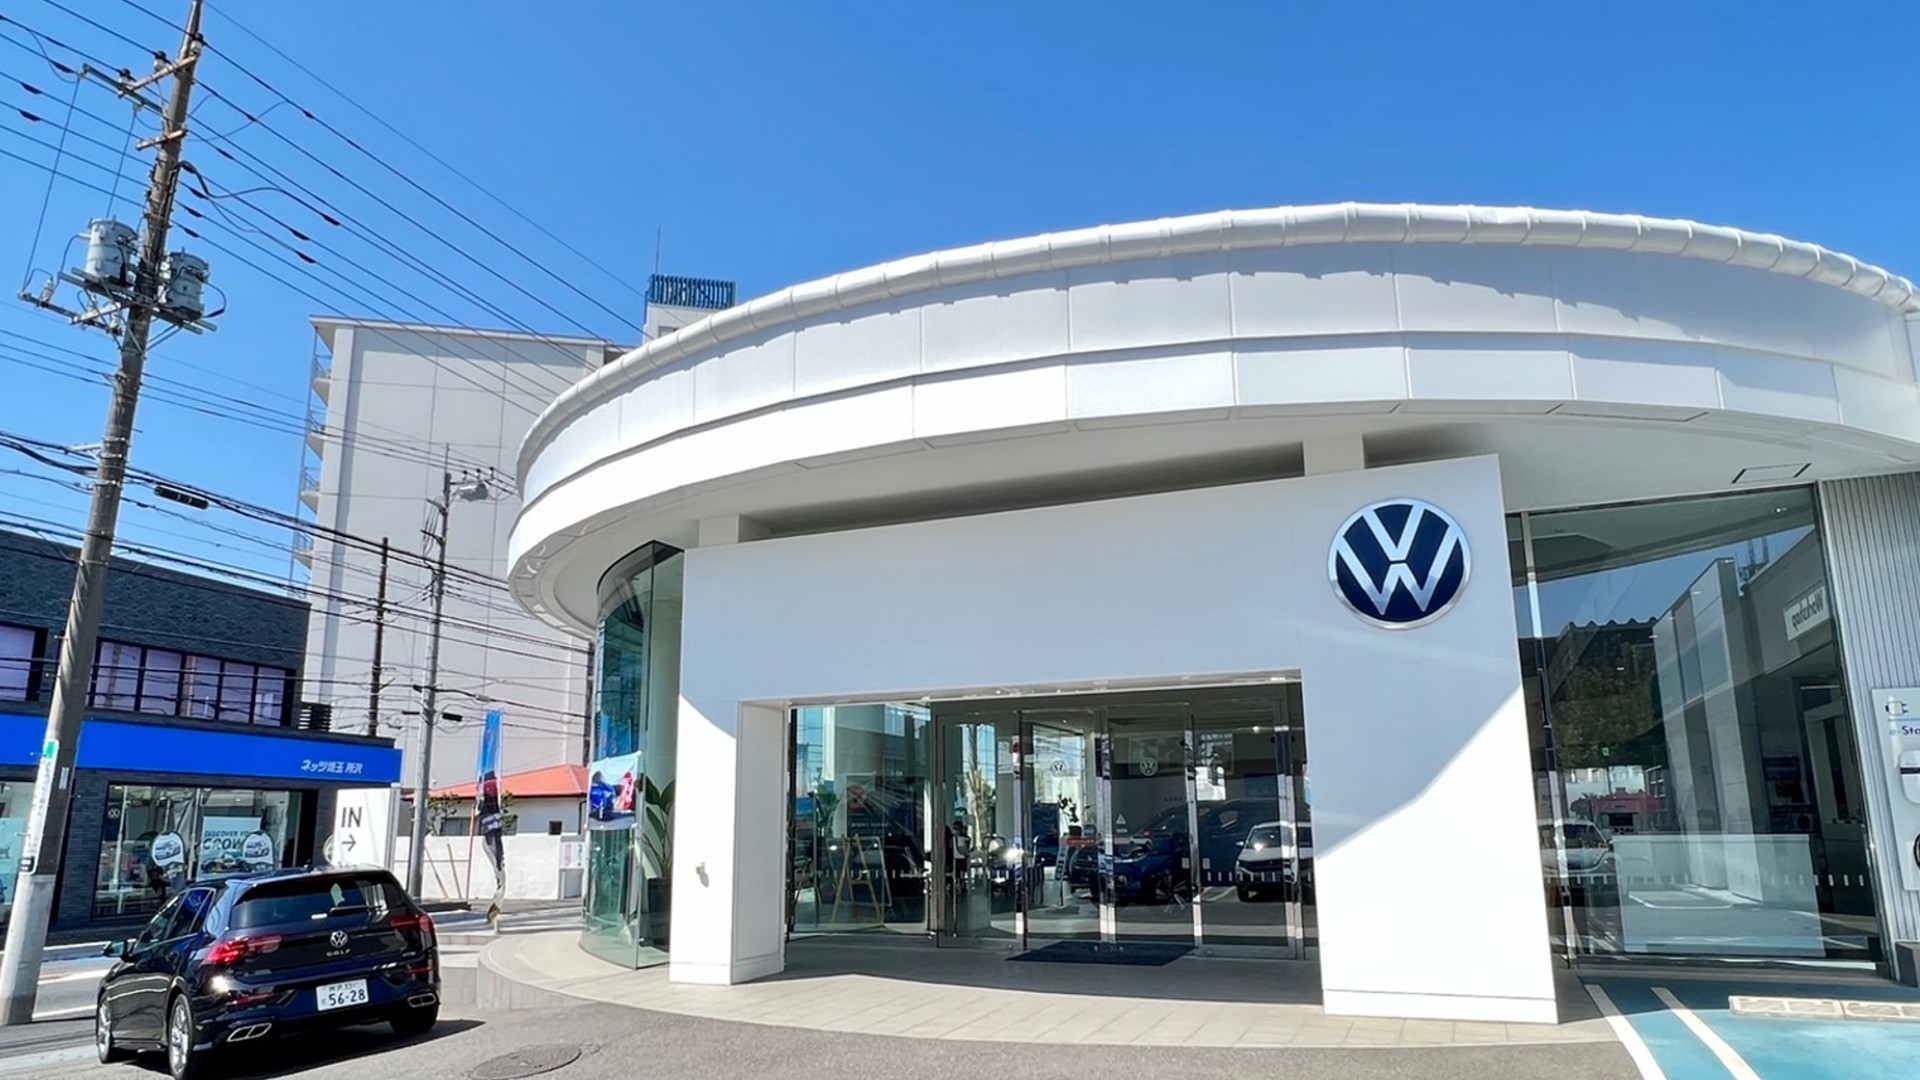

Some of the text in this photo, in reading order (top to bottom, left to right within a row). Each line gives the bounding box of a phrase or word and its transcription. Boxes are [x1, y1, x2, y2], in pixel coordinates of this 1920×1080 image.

[341, 807, 363, 828] IN
[203, 838, 242, 850] CROW
[326, 948, 351, 957] GOLF
[328, 988, 366, 1007] 56-28
